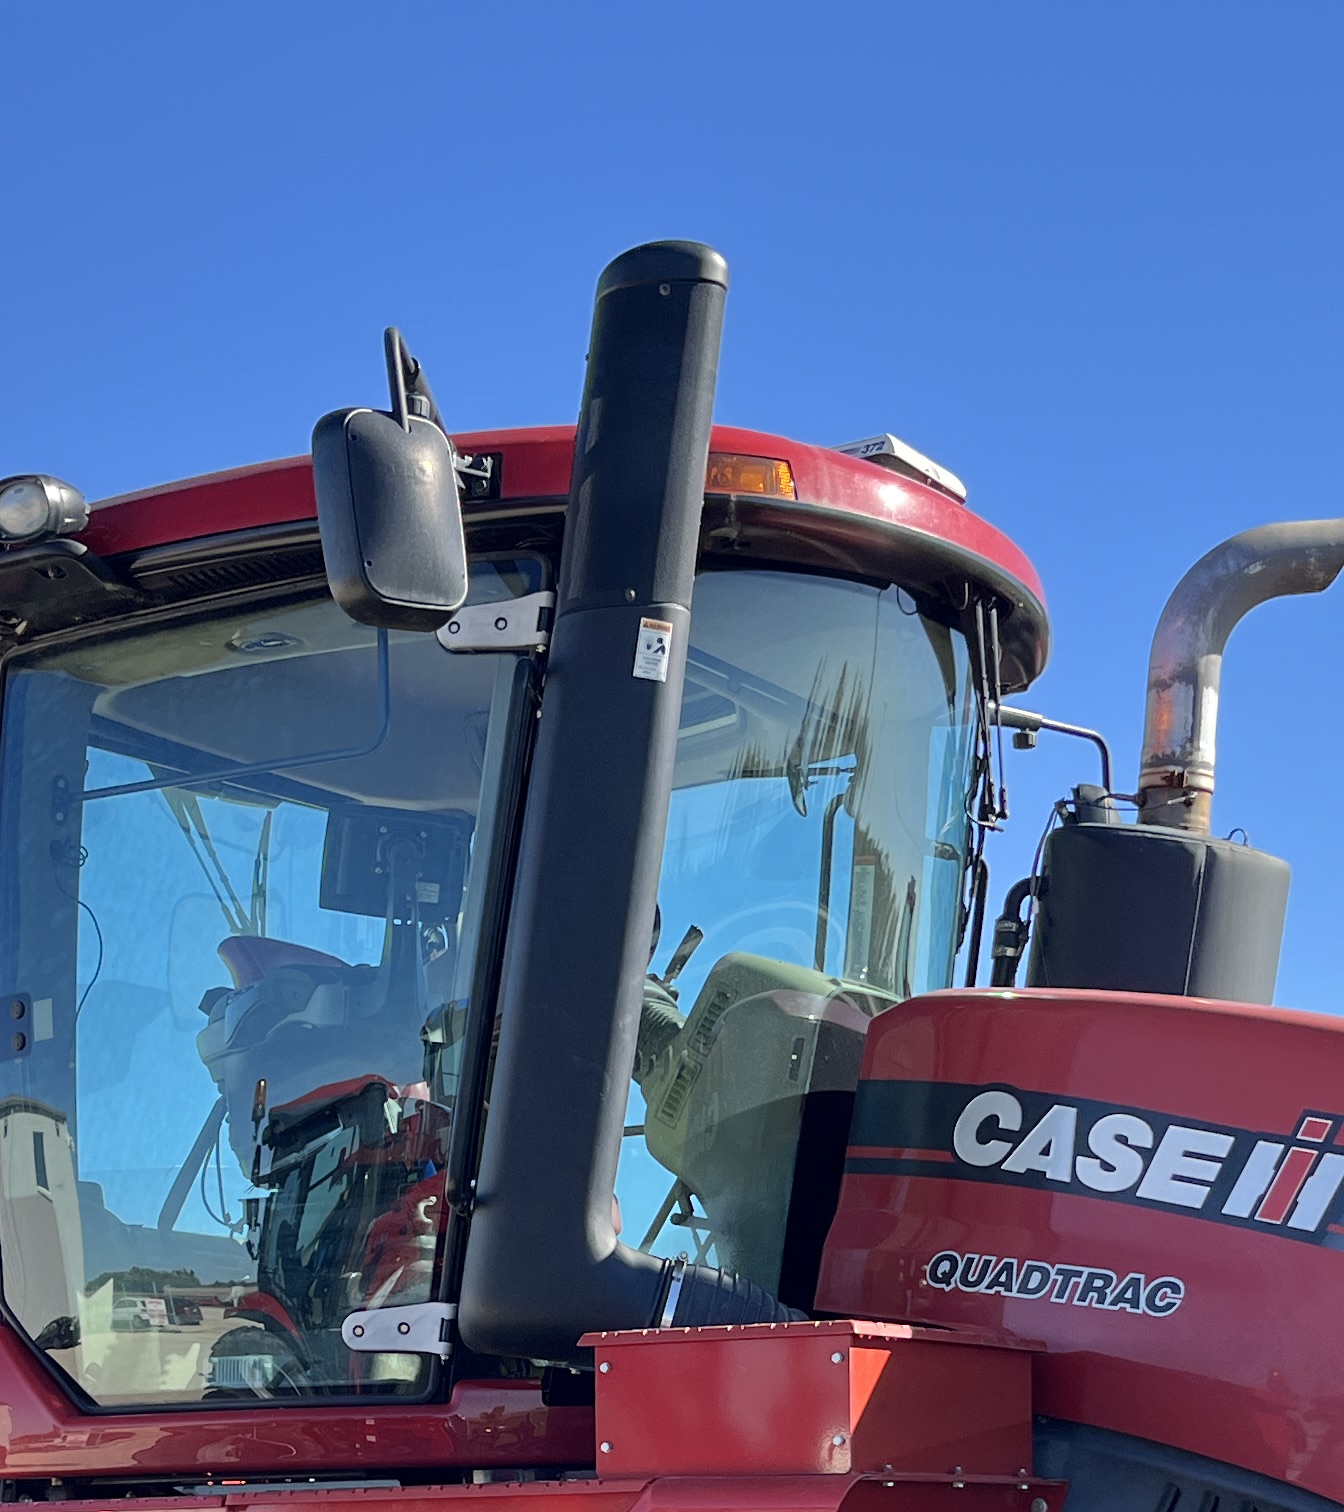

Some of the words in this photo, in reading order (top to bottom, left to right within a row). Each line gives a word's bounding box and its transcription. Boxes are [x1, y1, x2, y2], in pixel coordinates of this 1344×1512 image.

[861, 441, 886, 454] 372
[953, 1091, 1235, 1209] CASE
[926, 1251, 1185, 1317] QUADTRAC
